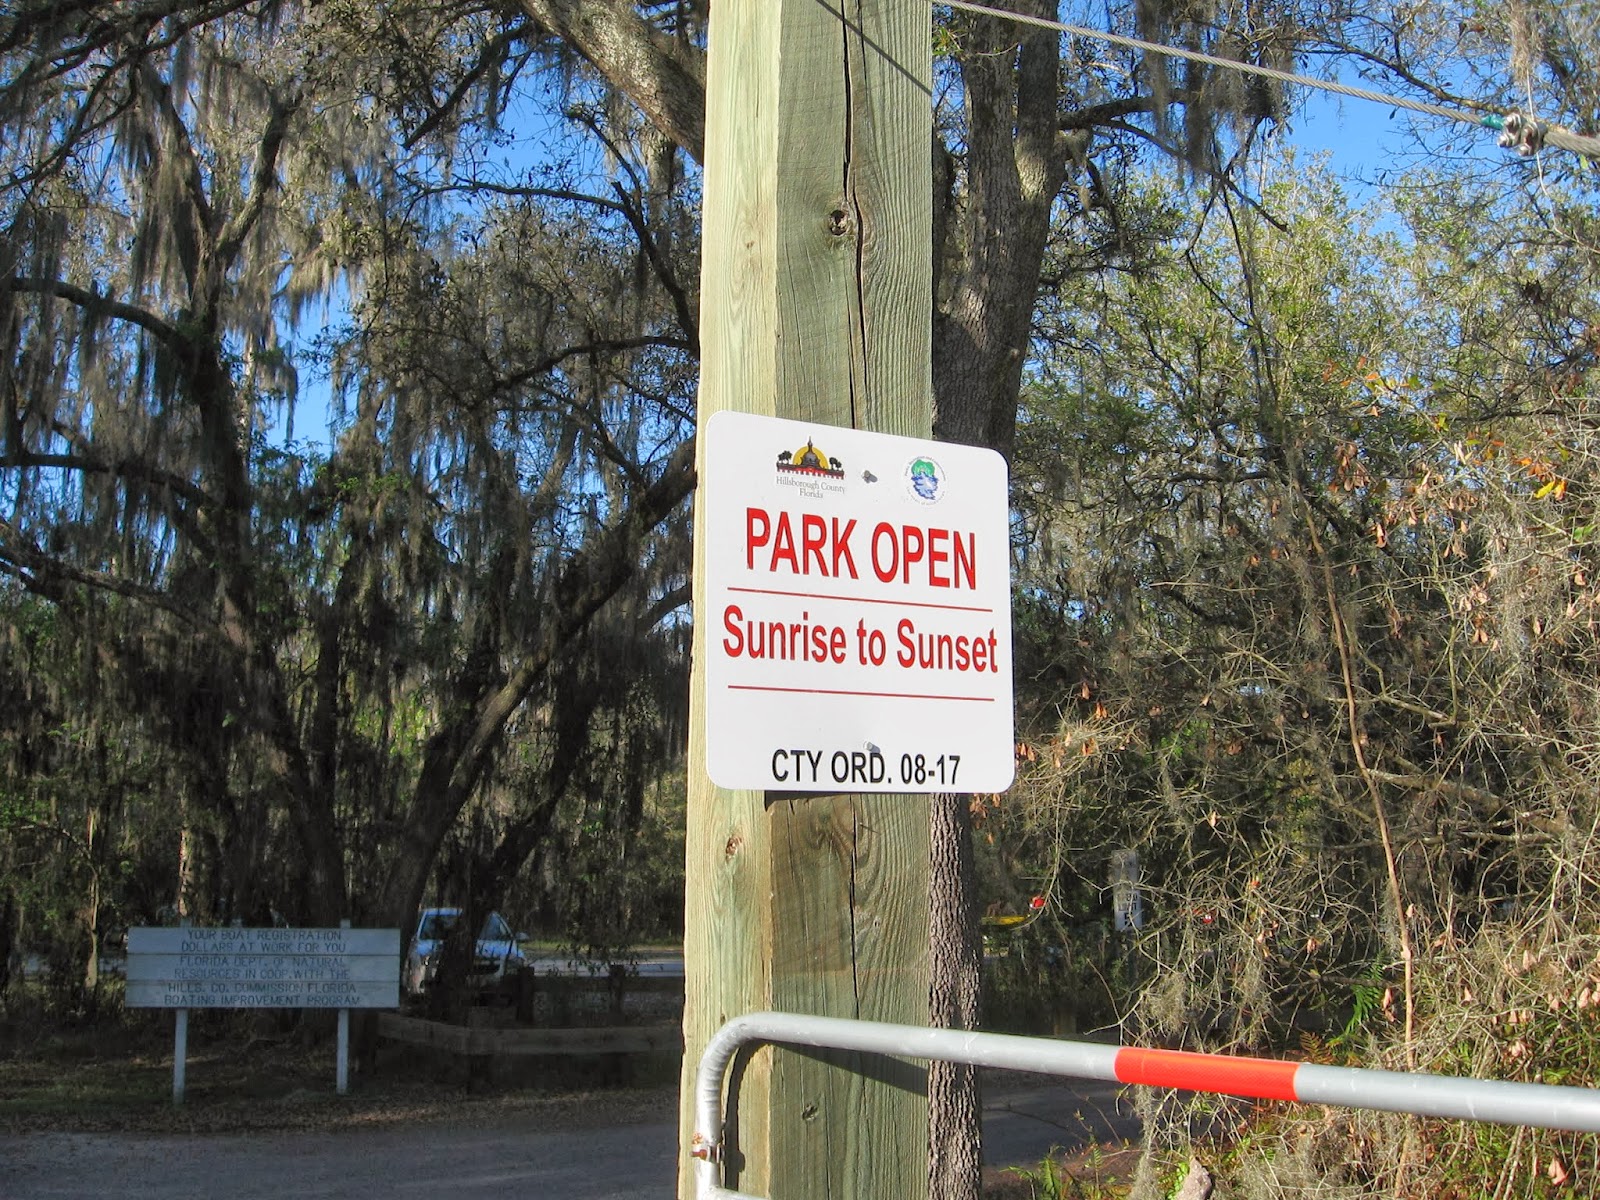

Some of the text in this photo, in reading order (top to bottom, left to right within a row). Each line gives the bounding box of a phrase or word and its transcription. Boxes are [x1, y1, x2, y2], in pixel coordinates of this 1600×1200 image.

[776, 476, 845, 494] Hillsborough County
[747, 507, 976, 590] PARK OPEN
[723, 604, 998, 673] Sunrise to Sunset
[771, 748, 961, 785] CTY ORD. 08-17
[187, 929, 341, 941] YOUR BOAT REGISTRATION
[181, 941, 347, 953] DOLLARS AT WORK FOR YOU
[180, 956, 229, 967] FLORIDA
[273, 957, 285, 968] OF
[293, 957, 344, 968] NATURAL
[174, 968, 240, 979] RESOURCES
[246, 969, 256, 979] IN
[330, 970, 350, 980] THE
[168, 982, 357, 994] HILLS. CO. COMMISSION FLORIDA
[164, 994, 360, 1006] BOATING IMPROVEMENT PROGRAM
